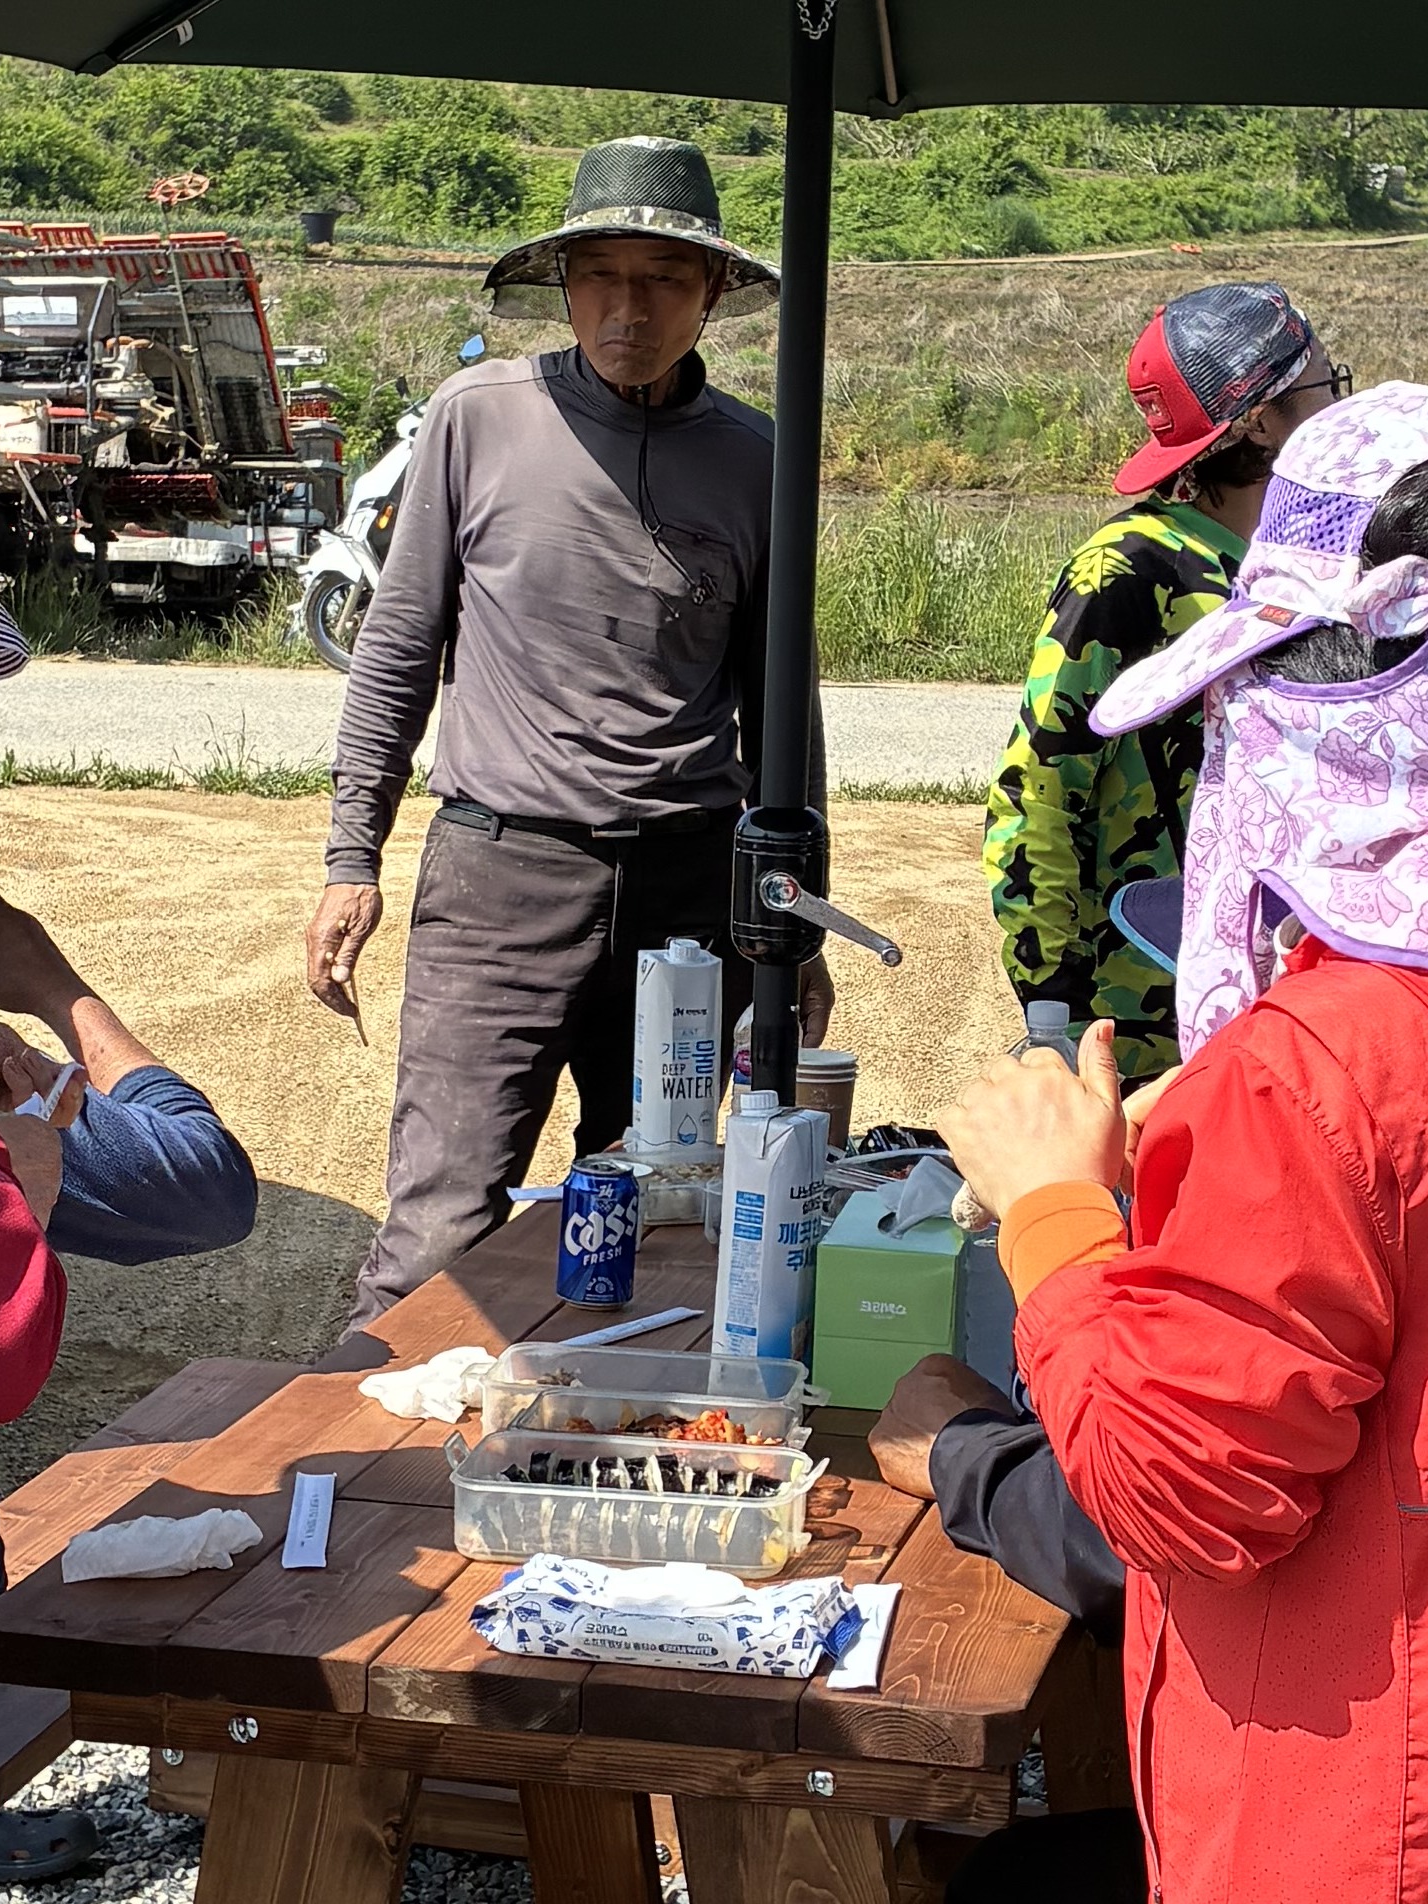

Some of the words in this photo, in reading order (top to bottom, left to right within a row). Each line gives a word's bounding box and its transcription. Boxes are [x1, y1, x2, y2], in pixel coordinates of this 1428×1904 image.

[661, 1064, 686, 1077] DEEP
[661, 1076, 714, 1100] WATER
[582, 1246, 623, 1267] FRESH
